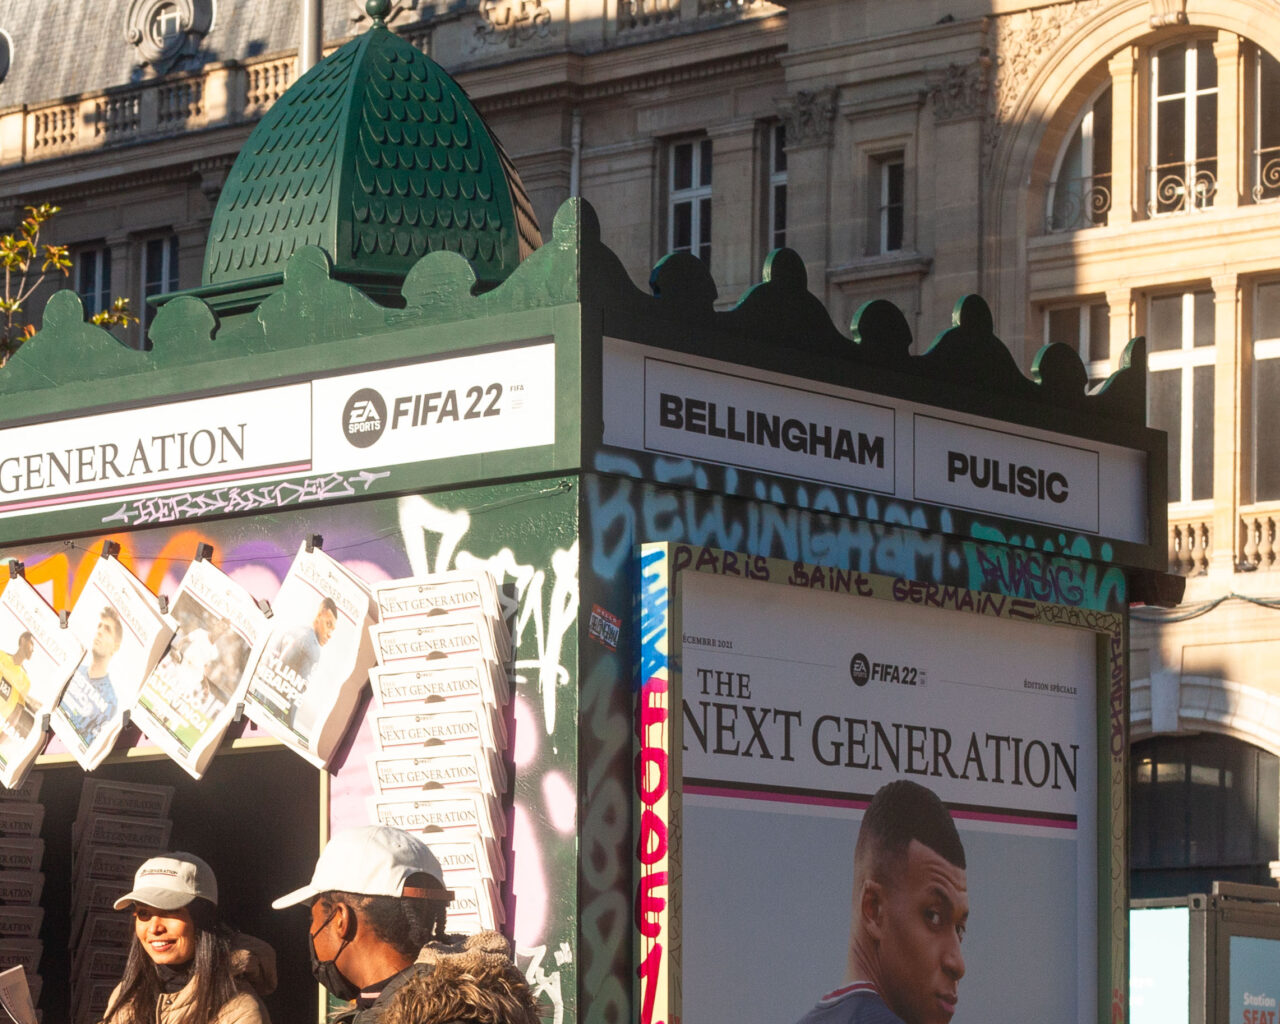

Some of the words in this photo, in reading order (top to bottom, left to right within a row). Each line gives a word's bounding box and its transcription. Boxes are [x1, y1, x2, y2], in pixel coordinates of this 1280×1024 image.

[350, 400, 381, 421] EA
[348, 419, 381, 434] SPORTS
[659, 393, 885, 469] BELLINGHAM
[948, 451, 1069, 503] PULISIC
[411, 591, 480, 609] GENERATION
[410, 634, 479, 652] GENERATION
[682, 632, 716, 647] ÉCEMBRE
[409, 679, 478, 695] GENERATION
[697, 668, 751, 699] THE
[408, 722, 478, 738] GENERATION
[682, 699, 802, 761] NEXT
[812, 715, 1079, 792] GENERATION
[406, 766, 477, 782] GENERATION
[379, 814, 406, 827] EXT
[406, 810, 476, 825] GENERATION
[1243, 992, 1276, 1006] Station
